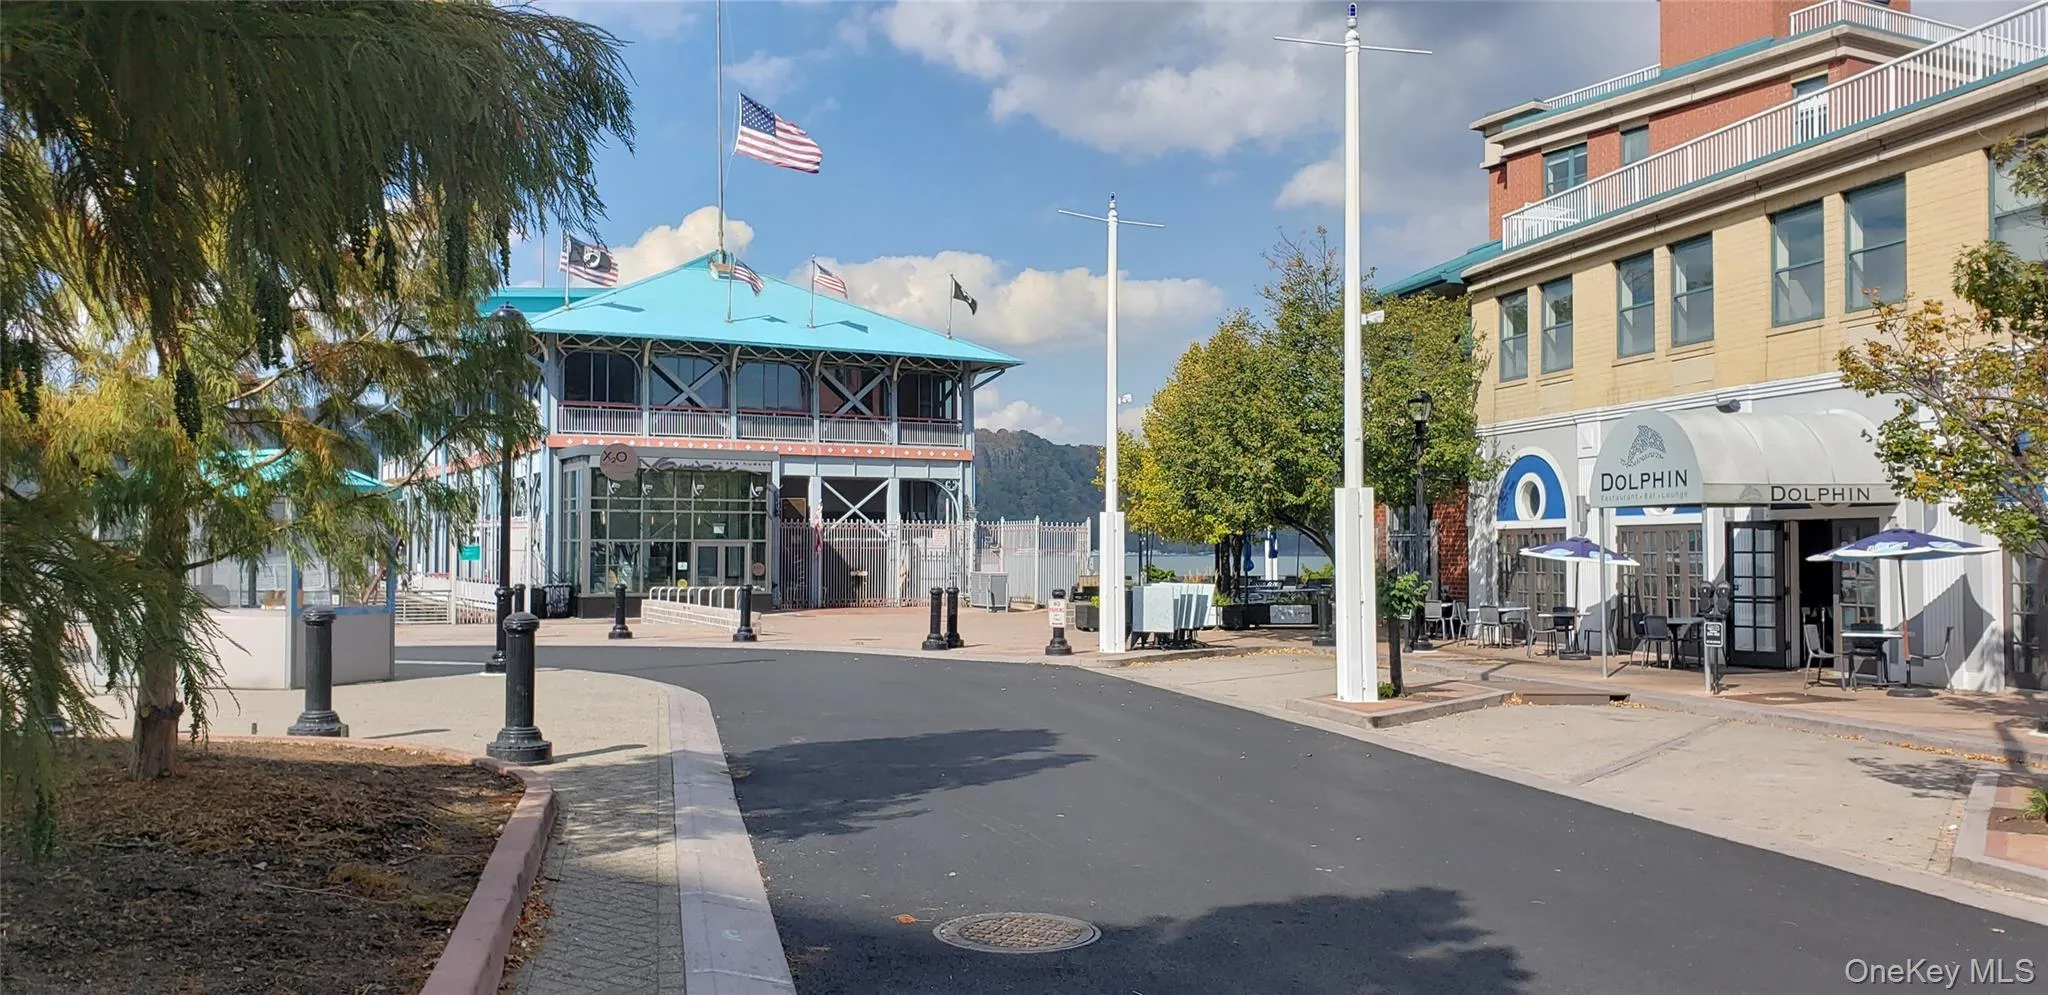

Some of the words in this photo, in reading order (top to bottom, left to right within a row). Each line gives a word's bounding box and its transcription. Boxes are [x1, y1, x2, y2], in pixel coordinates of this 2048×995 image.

[1601, 469, 1688, 492] DOLPHIN
[1601, 494, 1638, 502] Restaurant
[1661, 491, 1689, 500] Lounge
[1771, 485, 1870, 501] DOLPHIN
